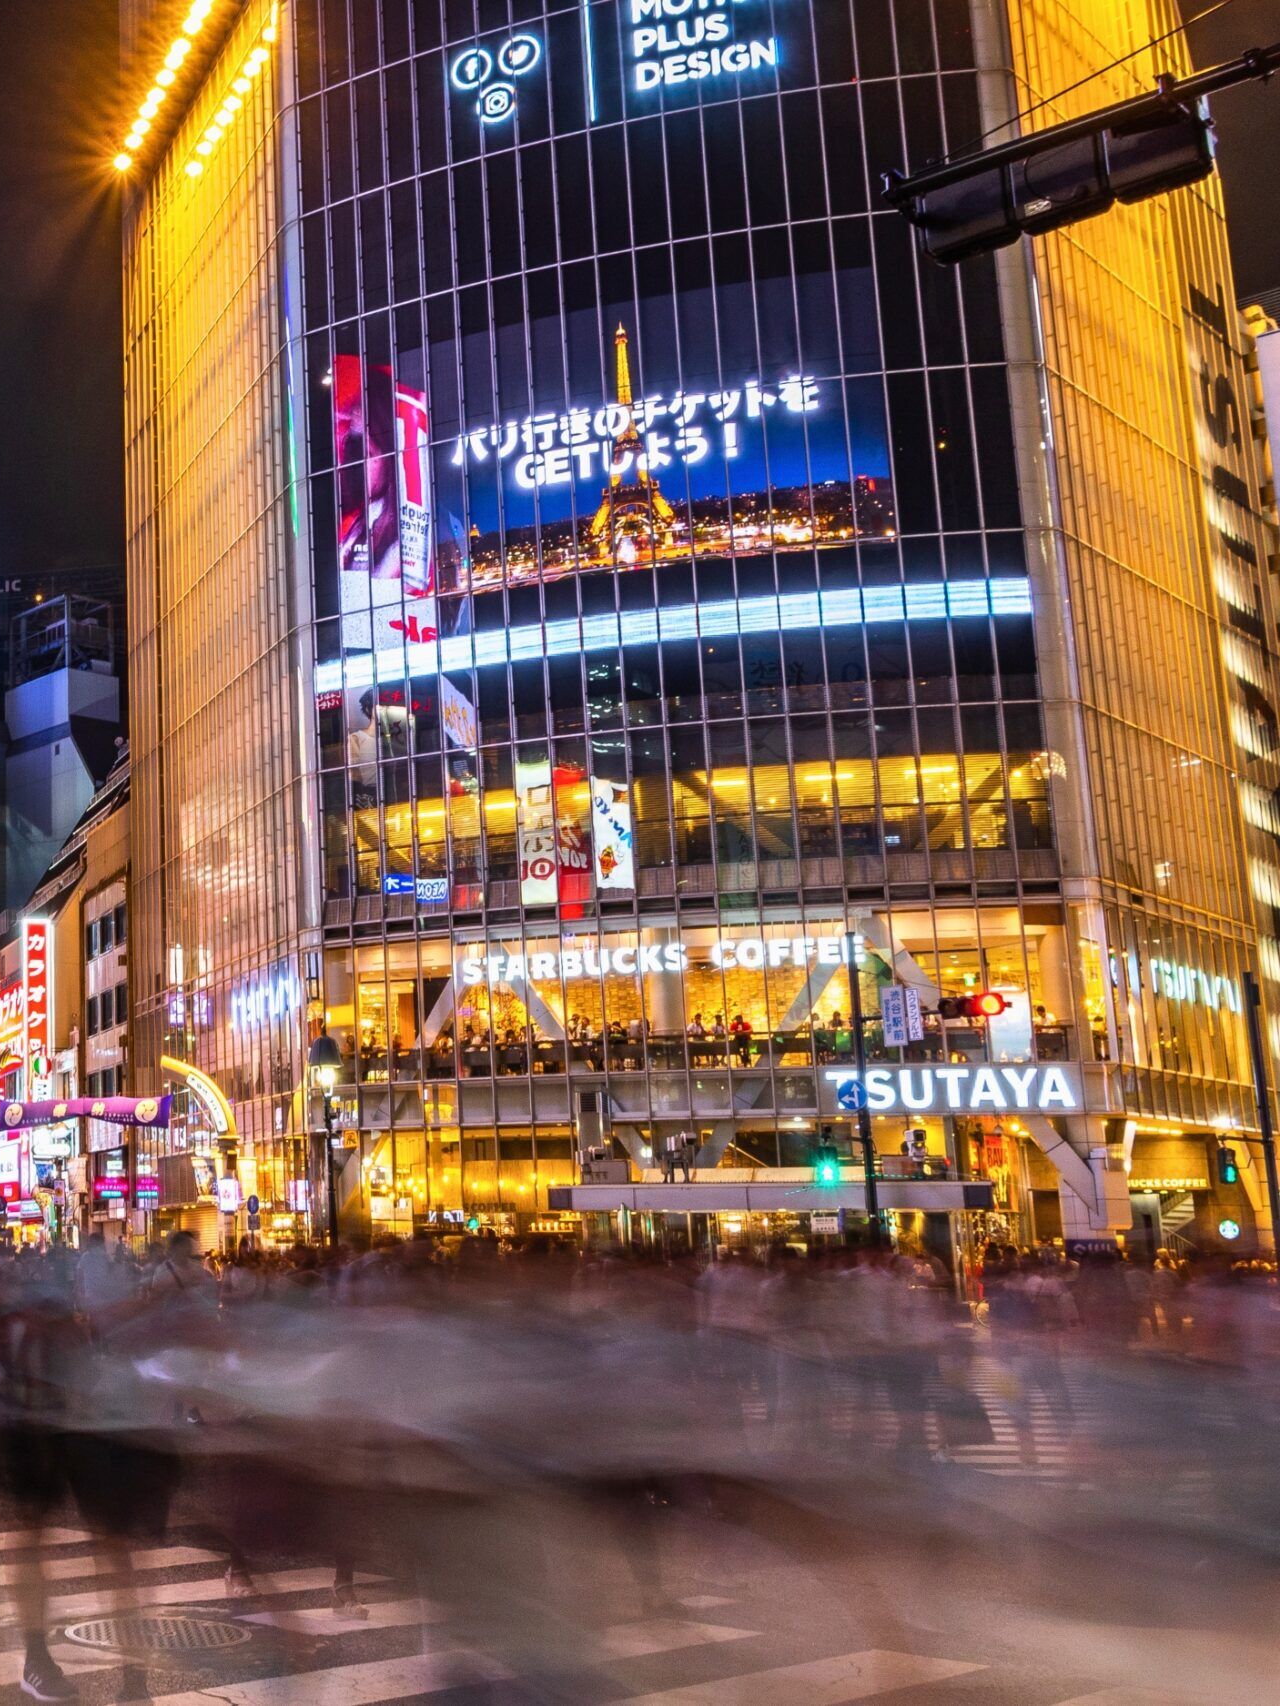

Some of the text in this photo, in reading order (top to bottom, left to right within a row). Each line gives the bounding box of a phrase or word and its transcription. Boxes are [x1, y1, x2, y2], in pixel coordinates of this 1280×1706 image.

[633, 13, 729, 57] PLUS
[636, 38, 776, 90] DESIGN
[454, 377, 819, 465] パリ行きのチケットを
[27, 934, 46, 1027] カラオケ
[462, 934, 864, 984] STARBUCKS COFFEE
[826, 1068, 1077, 1111] TSUTAYA
[1162, 1178, 1207, 1188] COFFEE
